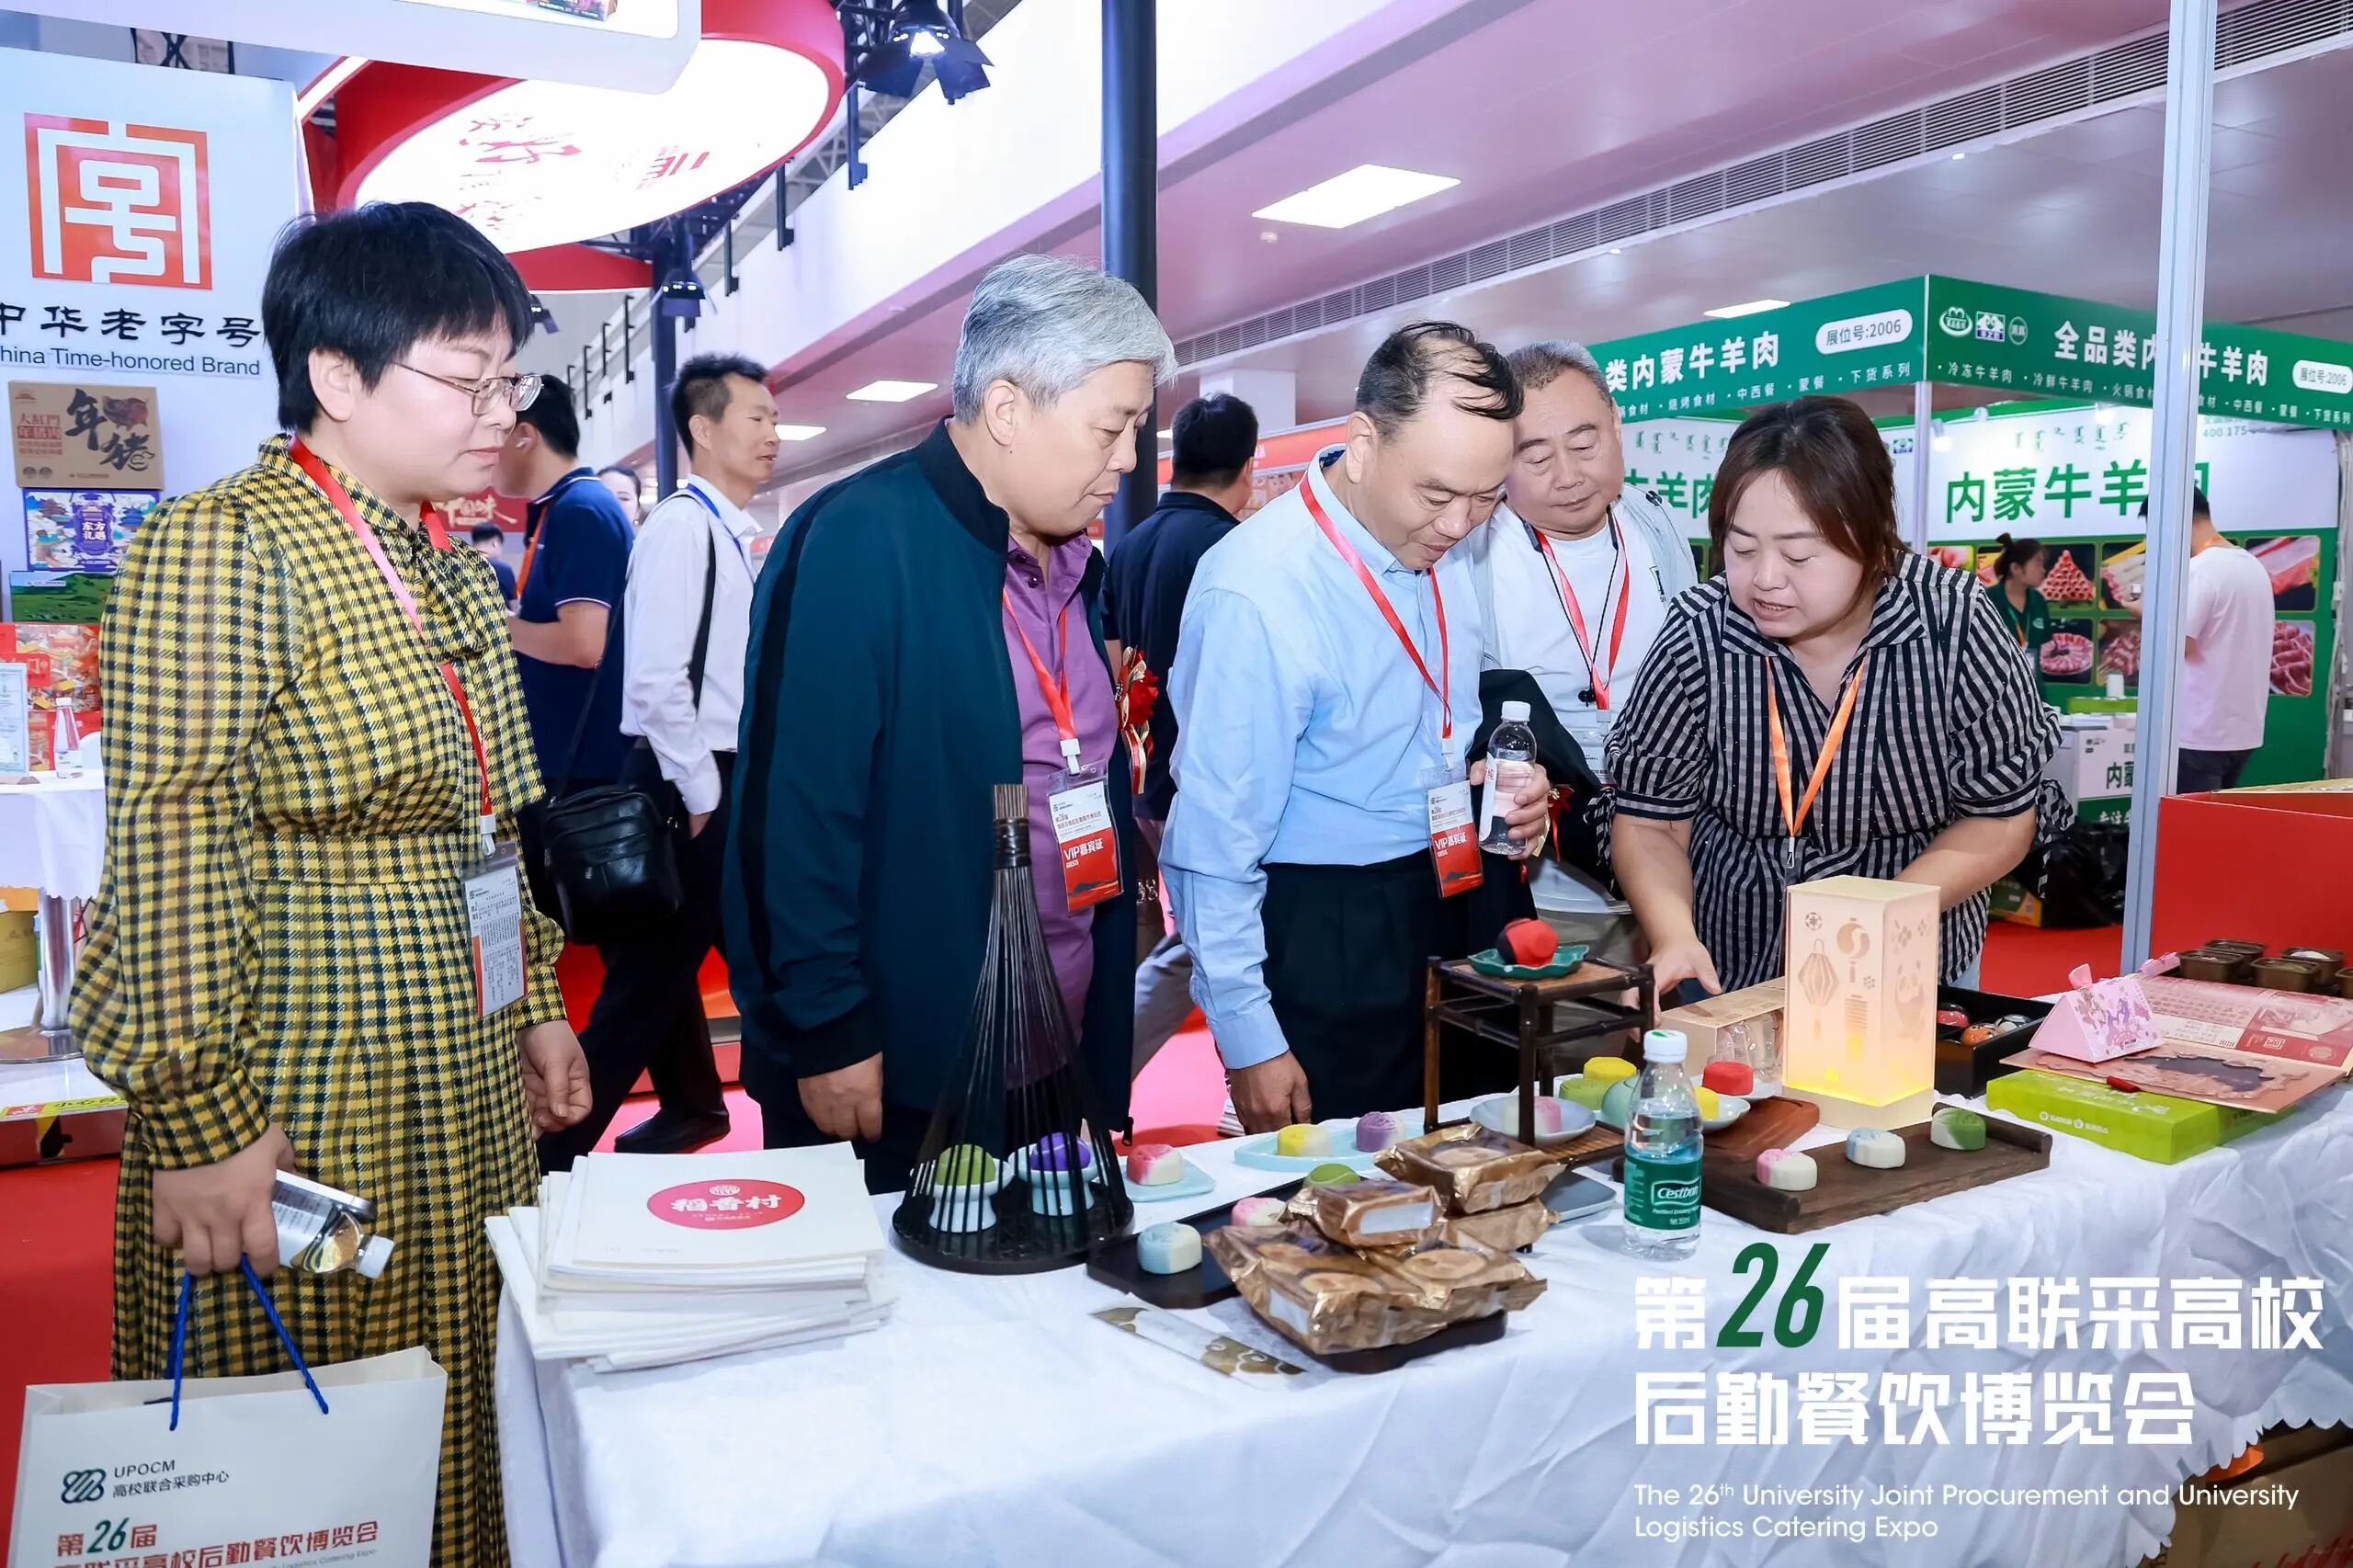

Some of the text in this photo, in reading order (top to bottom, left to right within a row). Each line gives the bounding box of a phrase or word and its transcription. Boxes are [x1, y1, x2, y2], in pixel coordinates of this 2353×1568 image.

[0, 301, 261, 347] 中华老字号
[1825, 318, 1902, 347] 展位号:2006
[0, 346, 260, 376] hina Time-honored Brand
[1736, 382, 1776, 401] 中西餐
[1850, 360, 1911, 386] 下货系列
[1948, 361, 2013, 383] 冷冻牛羊肉
[2033, 372, 2094, 394] 冷鲜牛羊肉
[112, 1471, 230, 1498] 高校联合采购中心
[114, 1459, 176, 1479] UPOCM
[57, 1517, 158, 1557] 第26届
